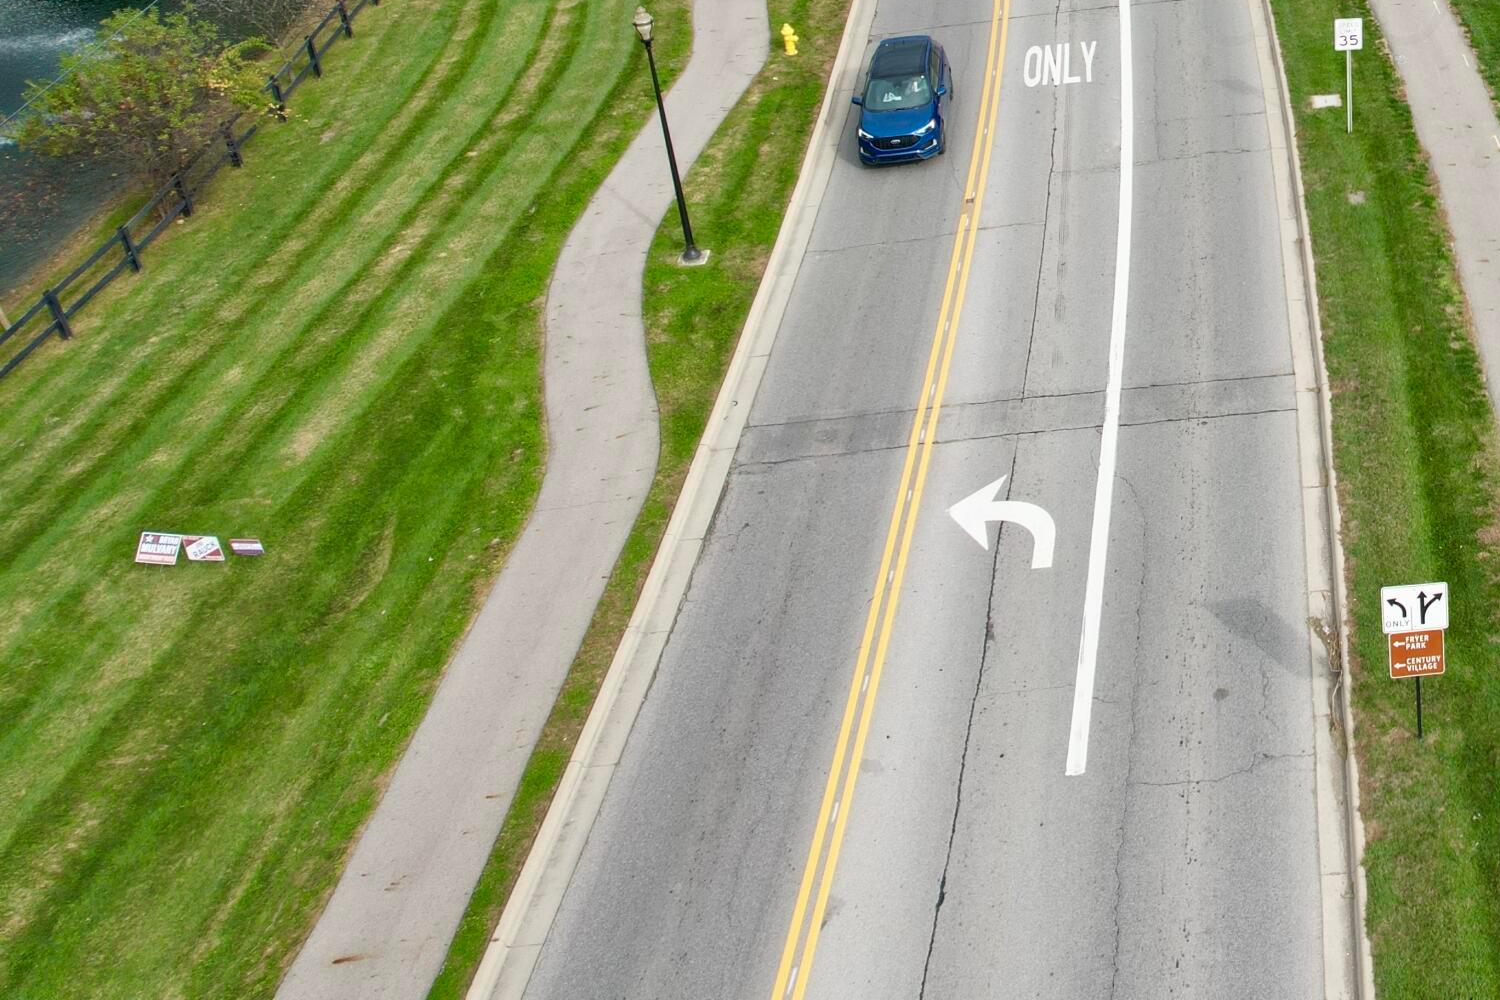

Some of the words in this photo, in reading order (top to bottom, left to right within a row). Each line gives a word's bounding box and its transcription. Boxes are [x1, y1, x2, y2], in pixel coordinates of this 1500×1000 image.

[1339, 34, 1359, 46] 35
[1023, 40, 1097, 88] ONLY
[1386, 619, 1410, 628] ONLY
[1405, 634, 1429, 643] FRYER
[1406, 642, 1426, 651] PARK
[1406, 655, 1441, 665] CENTURY
[1406, 662, 1438, 672] VILLAGE
